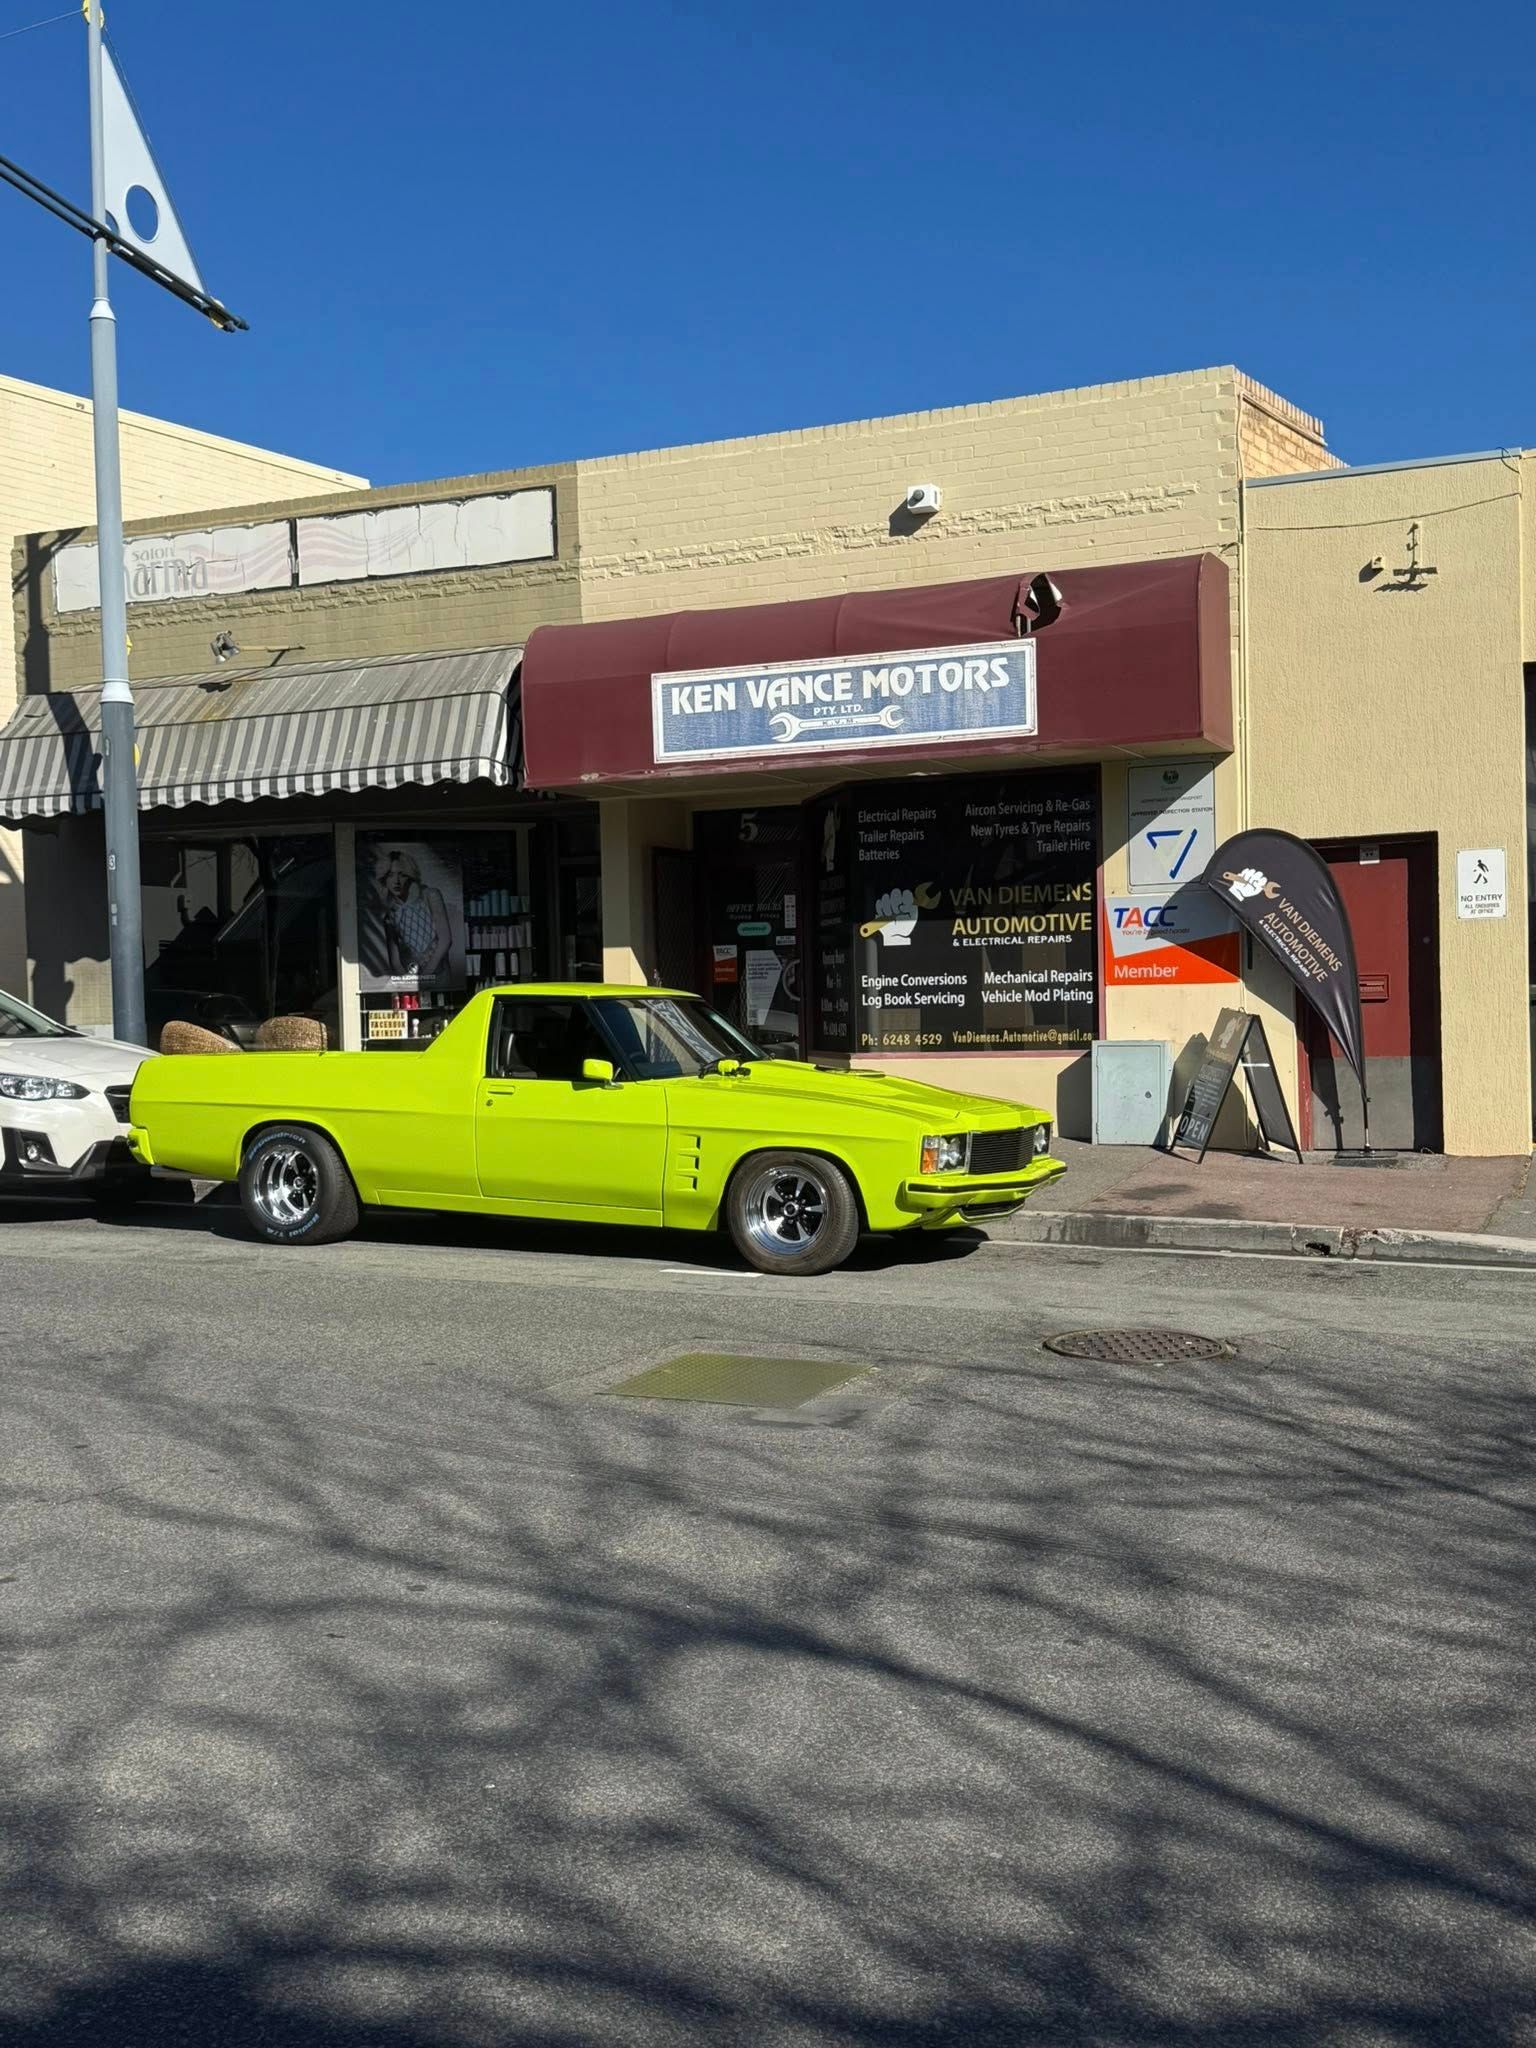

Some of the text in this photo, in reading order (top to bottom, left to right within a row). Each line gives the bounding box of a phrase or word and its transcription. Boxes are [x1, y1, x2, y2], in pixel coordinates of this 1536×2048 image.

[132, 547, 175, 561] salon
[671, 657, 1010, 716] KEN VANCE MOTORS
[813, 704, 864, 716] PTY. LTD.
[858, 807, 937, 823] Electrical Repairs
[965, 799, 1090, 816] Aircon Servicing & Re-Gas
[740, 810, 758, 842] 5
[970, 819, 1091, 839] New Tyres & Tyre Repairs
[859, 828, 925, 844] Trailer Repairs
[1036, 838, 1091, 853] Trailer Hire
[859, 848, 900, 861] Batteries
[949, 882, 1092, 906] VAN DIEMENS
[1475, 894, 1503, 902] ENTRY
[952, 912, 1092, 935] AUTOMOTIVE
[1114, 905, 1178, 928] TACC
[952, 934, 1073, 947] & ELECTRICAL REPAIRS
[1262, 923, 1292, 956] ELECTRICAL
[1278, 897, 1343, 972] VAN DIEMENS
[1263, 912, 1329, 983] AUTOMOTIVE
[984, 969, 1093, 985] Mechanical Repairs
[1114, 964, 1179, 978] Member
[861, 972, 967, 990] Engine Conversions
[862, 993, 882, 1009] Log
[884, 992, 912, 1006] Book
[914, 992, 965, 1007] Servicing
[981, 988, 1094, 1003] Vehicle Mod Plating
[861, 1033, 943, 1046] Ph: 6248 4529
[1180, 1115, 1208, 1143] OPEN
